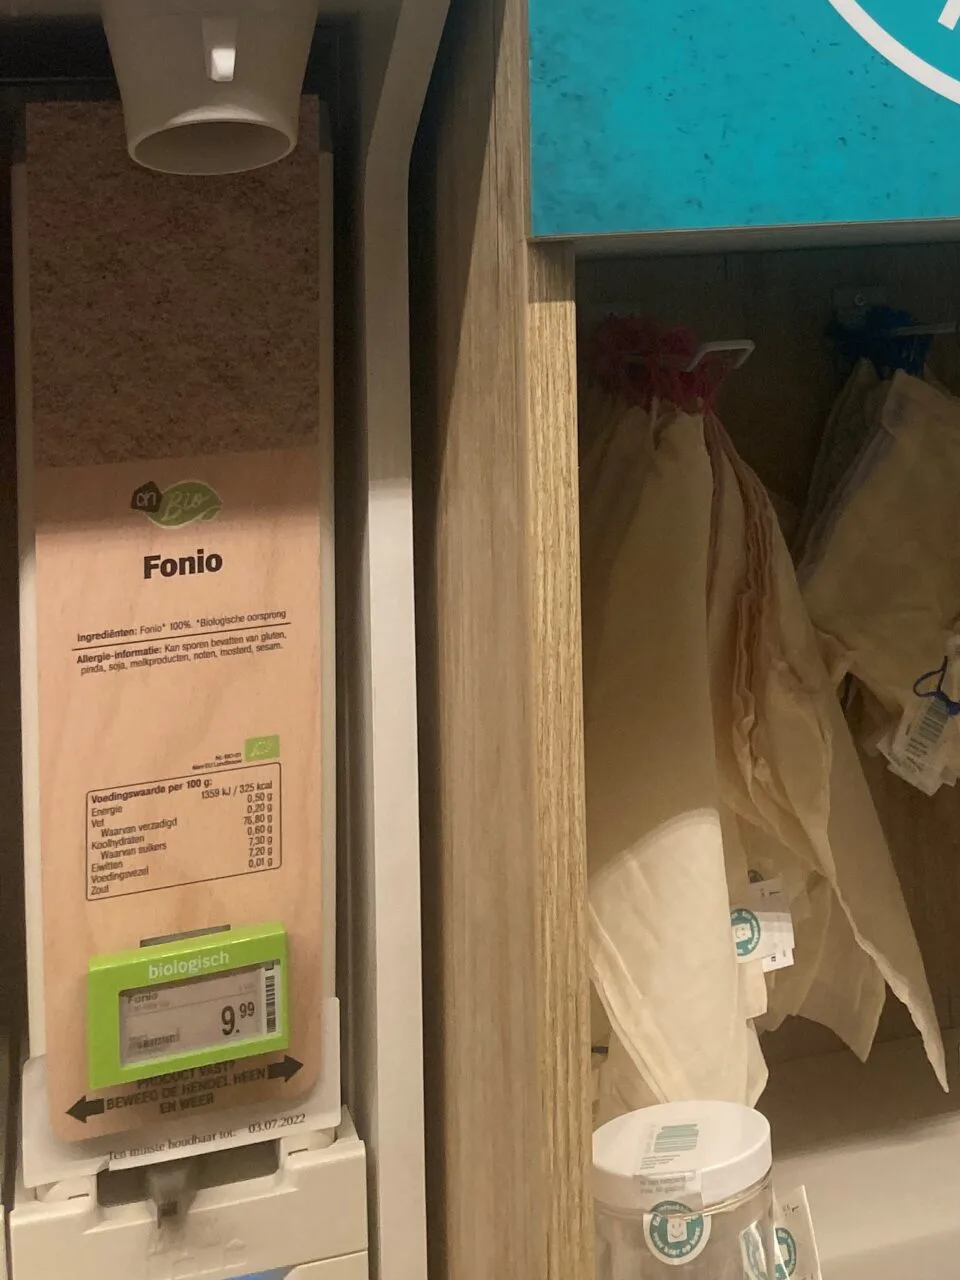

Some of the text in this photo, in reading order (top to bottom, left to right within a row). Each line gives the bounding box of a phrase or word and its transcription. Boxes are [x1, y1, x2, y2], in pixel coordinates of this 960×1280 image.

[143, 548, 224, 580] Fonio
[165, 643, 181, 654] Kan
[182, 639, 209, 653] sporen
[211, 635, 244, 649] bevatten
[246, 634, 259, 644] van
[91, 778, 202, 804] Voedingswaarde per 100
[91, 804, 123, 818] Energie
[240, 783, 255, 795] 325
[148, 949, 230, 980] biologisch
[106, 1089, 158, 1112] BEWEEG
[160, 1093, 215, 1114] EN WEER
[108, 1147, 127, 1162] Ten
[129, 1140, 165, 1157] minste
[167, 1131, 217, 1150] houdbaar
[248, 1113, 306, 1135] 03.07.2022
